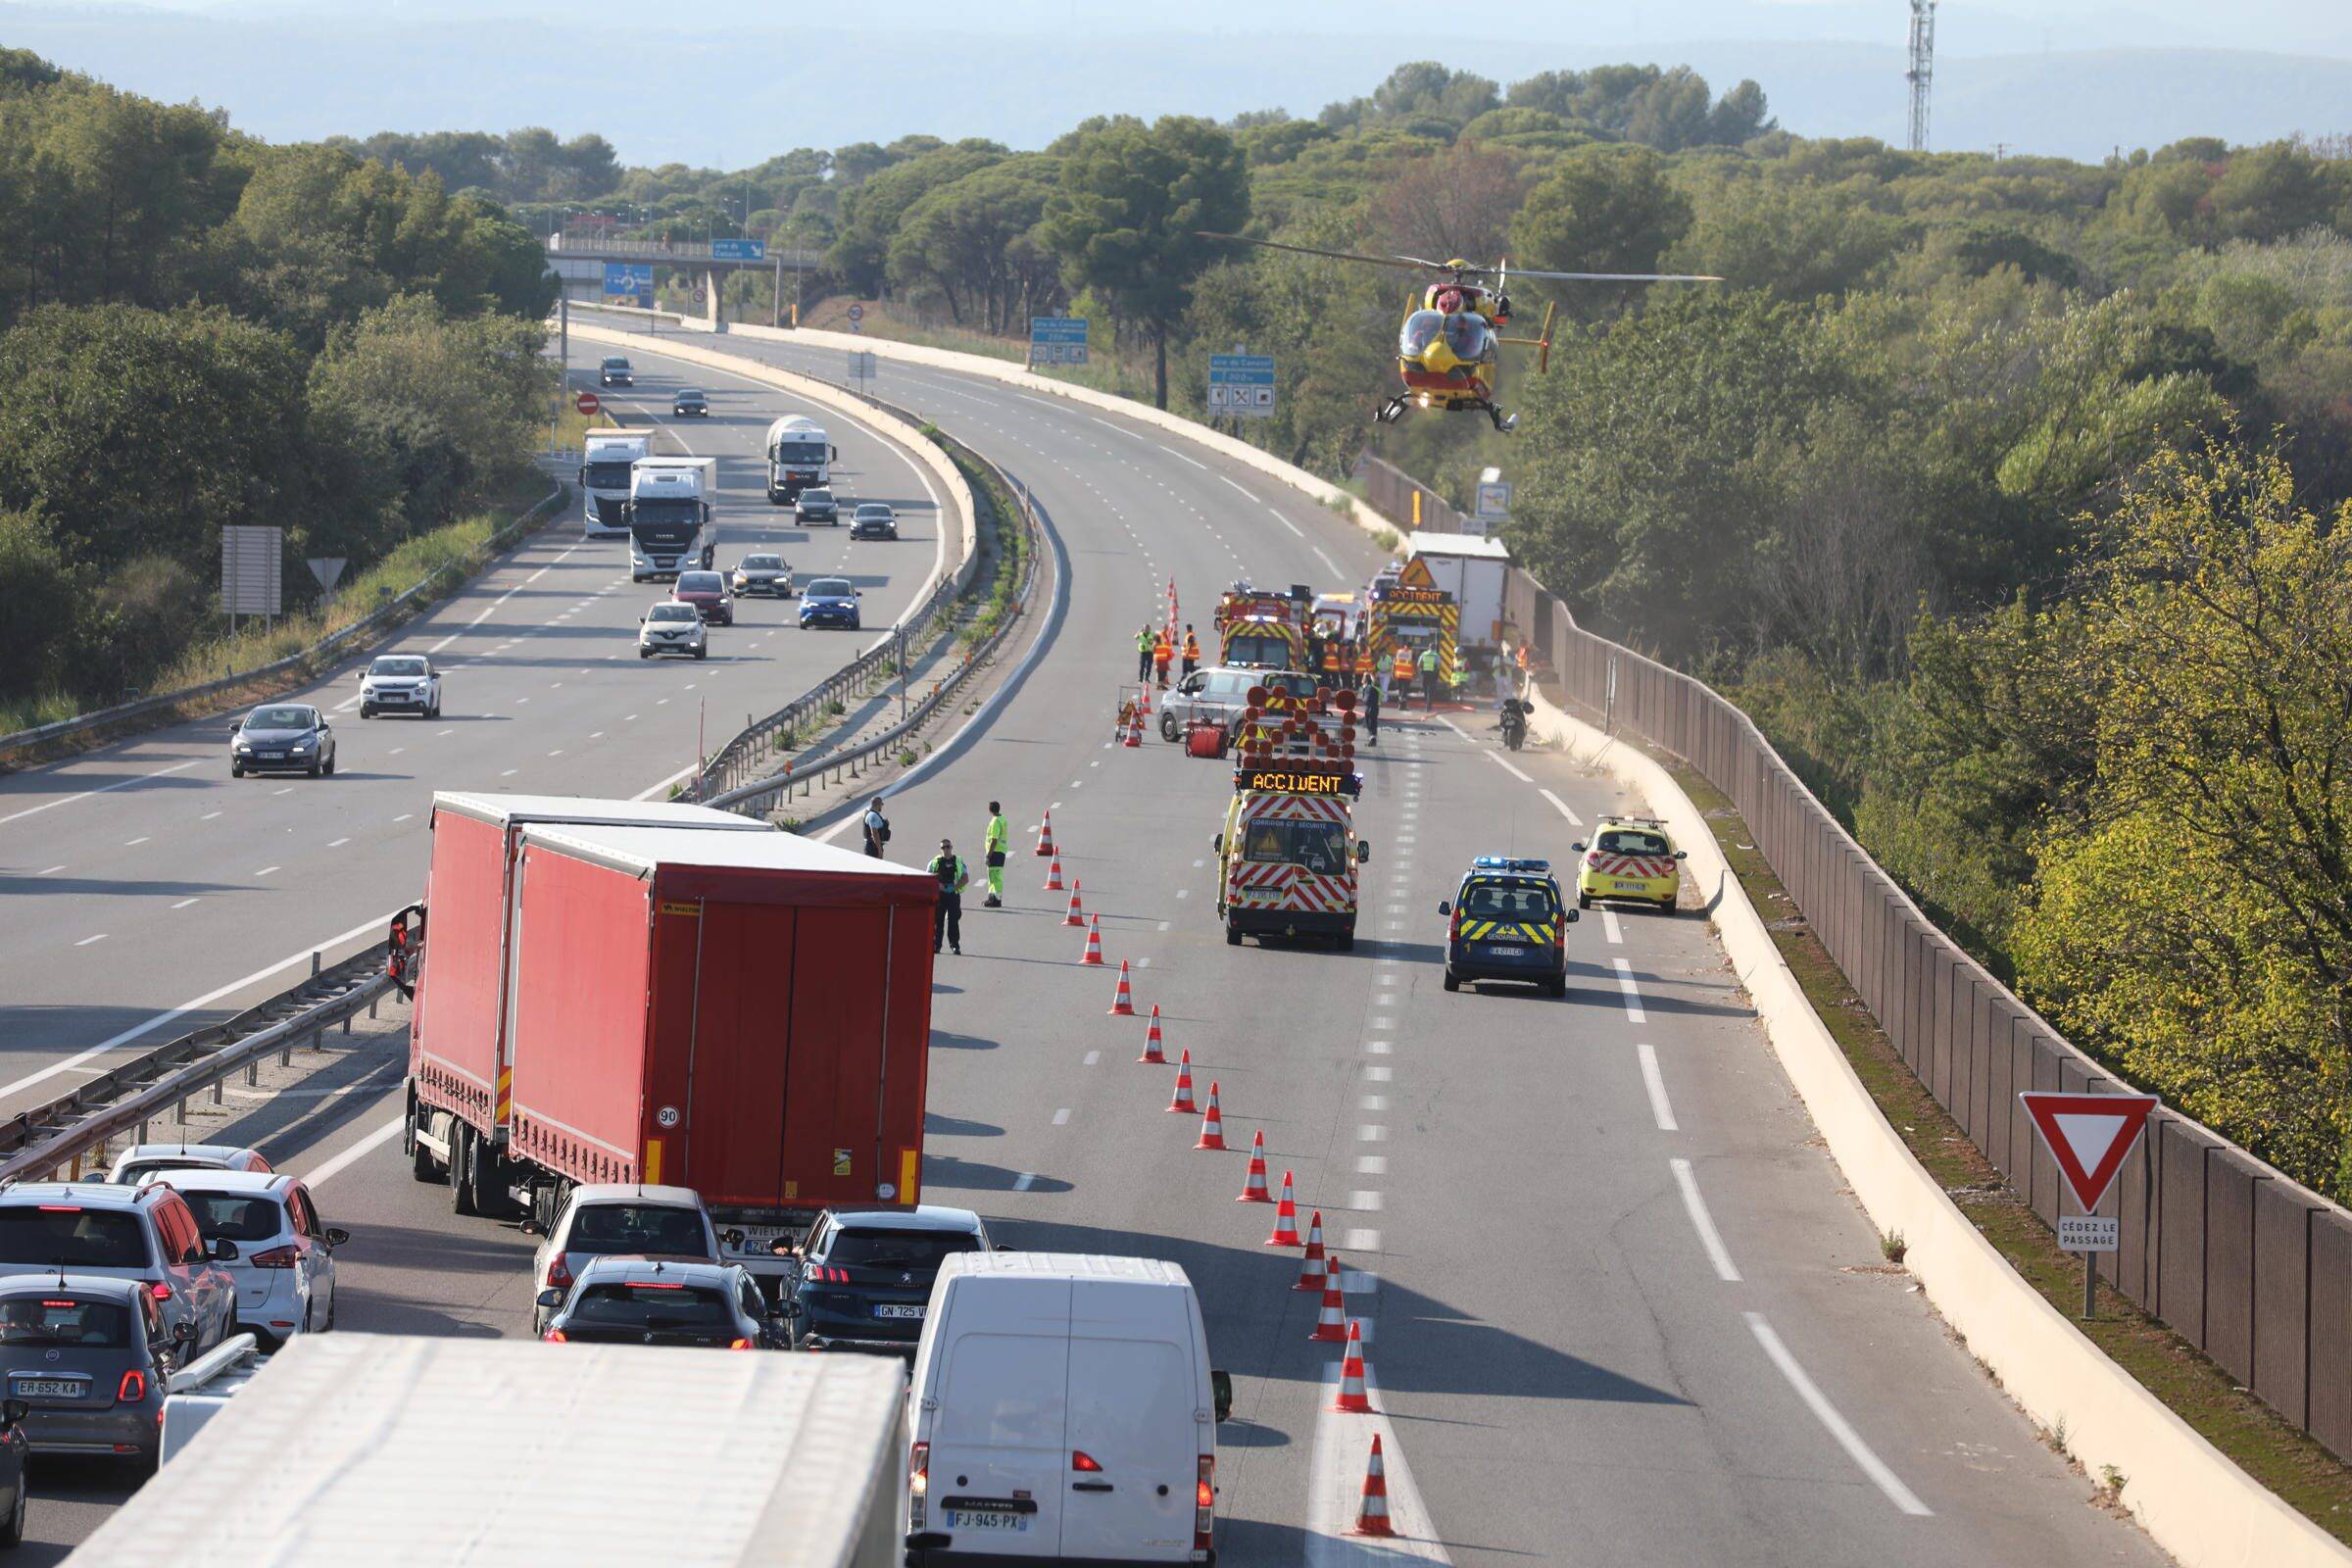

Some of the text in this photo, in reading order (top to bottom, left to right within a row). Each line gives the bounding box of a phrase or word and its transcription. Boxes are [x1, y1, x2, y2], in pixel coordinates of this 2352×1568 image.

[1389, 590, 1443, 601] ACCIDENT
[1487, 933, 1528, 942] GENDARMERIE
[661, 1107, 676, 1124] 90
[748, 1226, 801, 1238] WIELTON
[2061, 1221, 2116, 1232] CÉDEZ LE
[2063, 1236, 2115, 1245] PASSAGE
